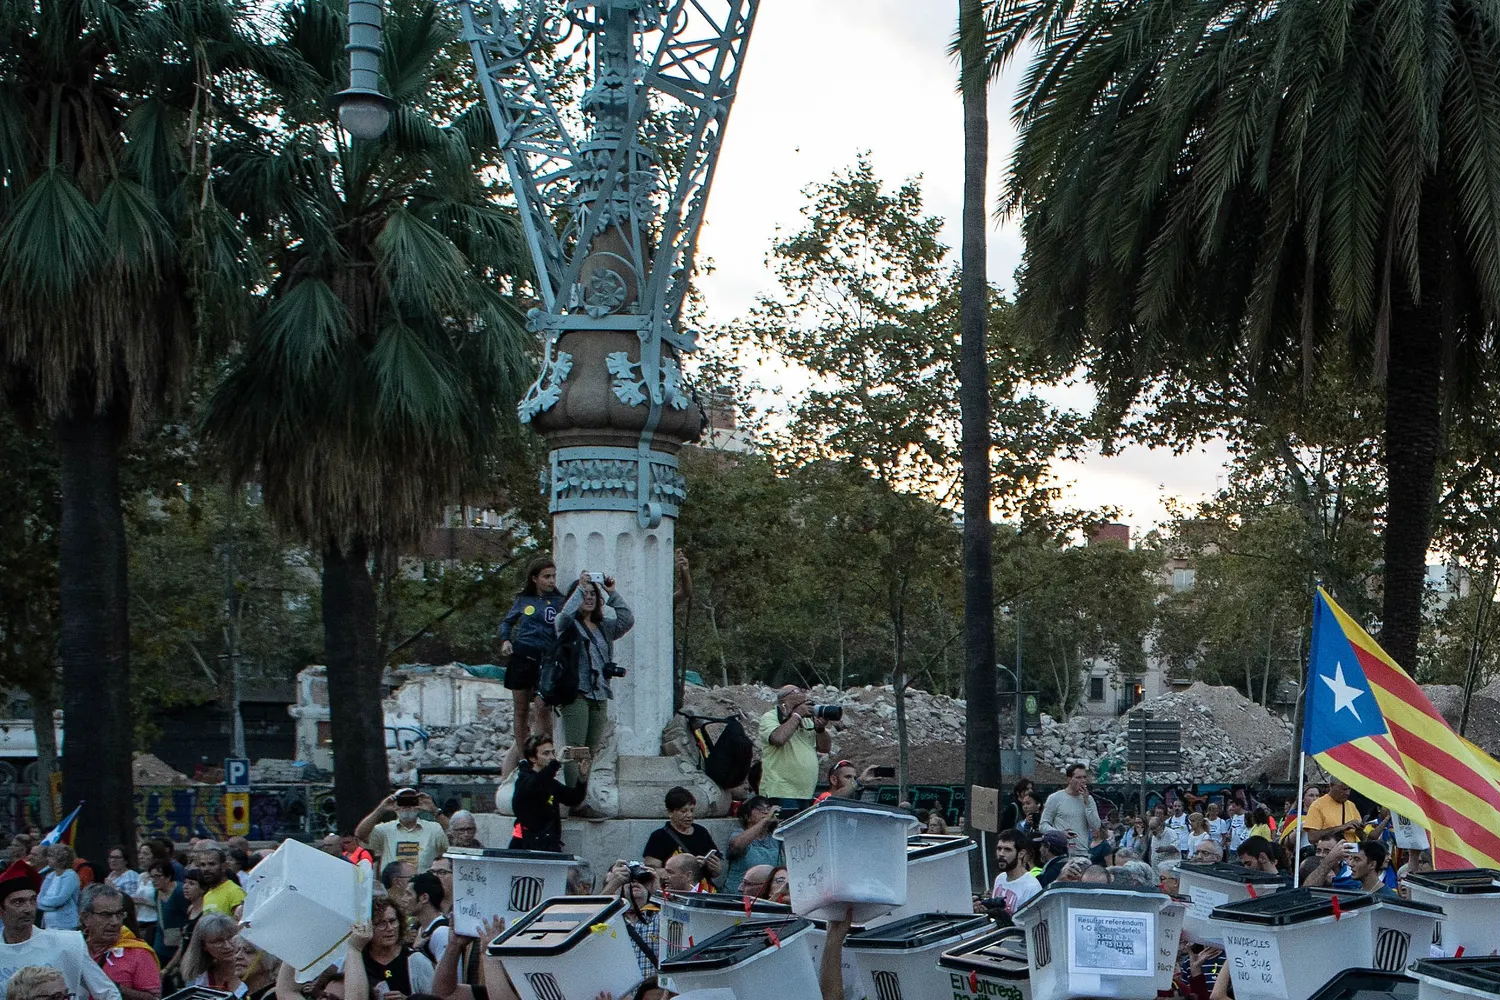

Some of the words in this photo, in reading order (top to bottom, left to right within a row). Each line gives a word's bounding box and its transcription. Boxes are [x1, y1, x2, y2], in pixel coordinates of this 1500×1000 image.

[230, 762, 245, 784] P
[1078, 916, 1104, 925] Resultat
[1098, 925, 1141, 935] Castelldefels
[950, 973, 965, 989] El
